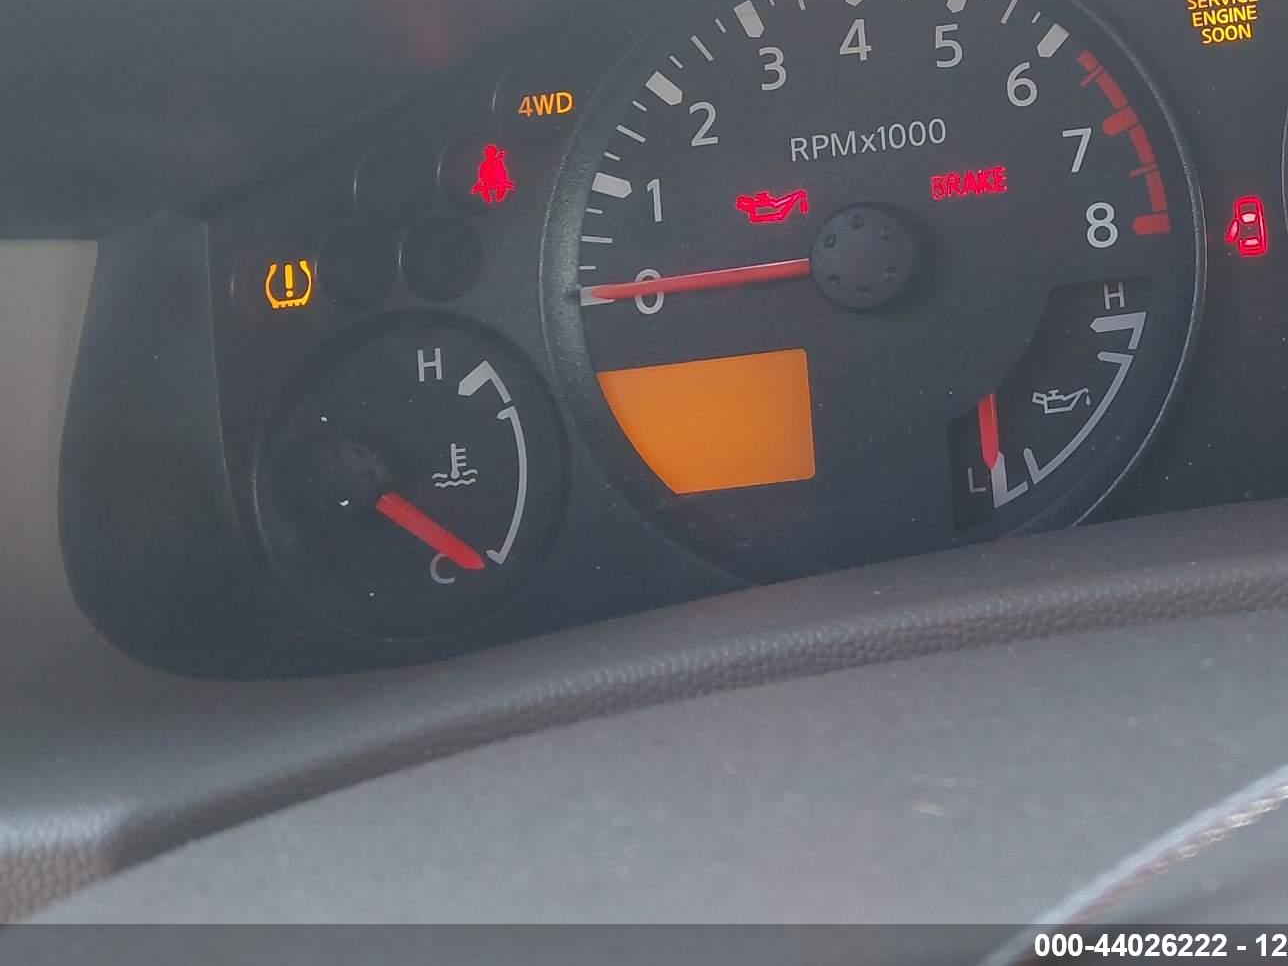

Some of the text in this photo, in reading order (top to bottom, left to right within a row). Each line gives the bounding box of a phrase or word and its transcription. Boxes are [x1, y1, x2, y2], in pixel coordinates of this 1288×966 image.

[1191, 6, 1257, 28] ENGINE
[1200, 23, 1252, 45] SOON
[839, 18, 872, 61] 4
[934, 24, 964, 68] 5
[758, 47, 788, 90] 3
[1006, 62, 1039, 107] 6
[517, 91, 573, 118] 4WD
[689, 102, 719, 147] 2
[790, 118, 948, 162] RPMx1000
[1062, 128, 1092, 173] 7
[645, 179, 663, 222] 1
[931, 167, 1008, 200] BRAKE
[1087, 203, 1119, 248] 8
[634, 269, 665, 315] 0
[1103, 283, 1125, 309] H
[417, 347, 443, 382] H
[967, 466, 986, 493] L
